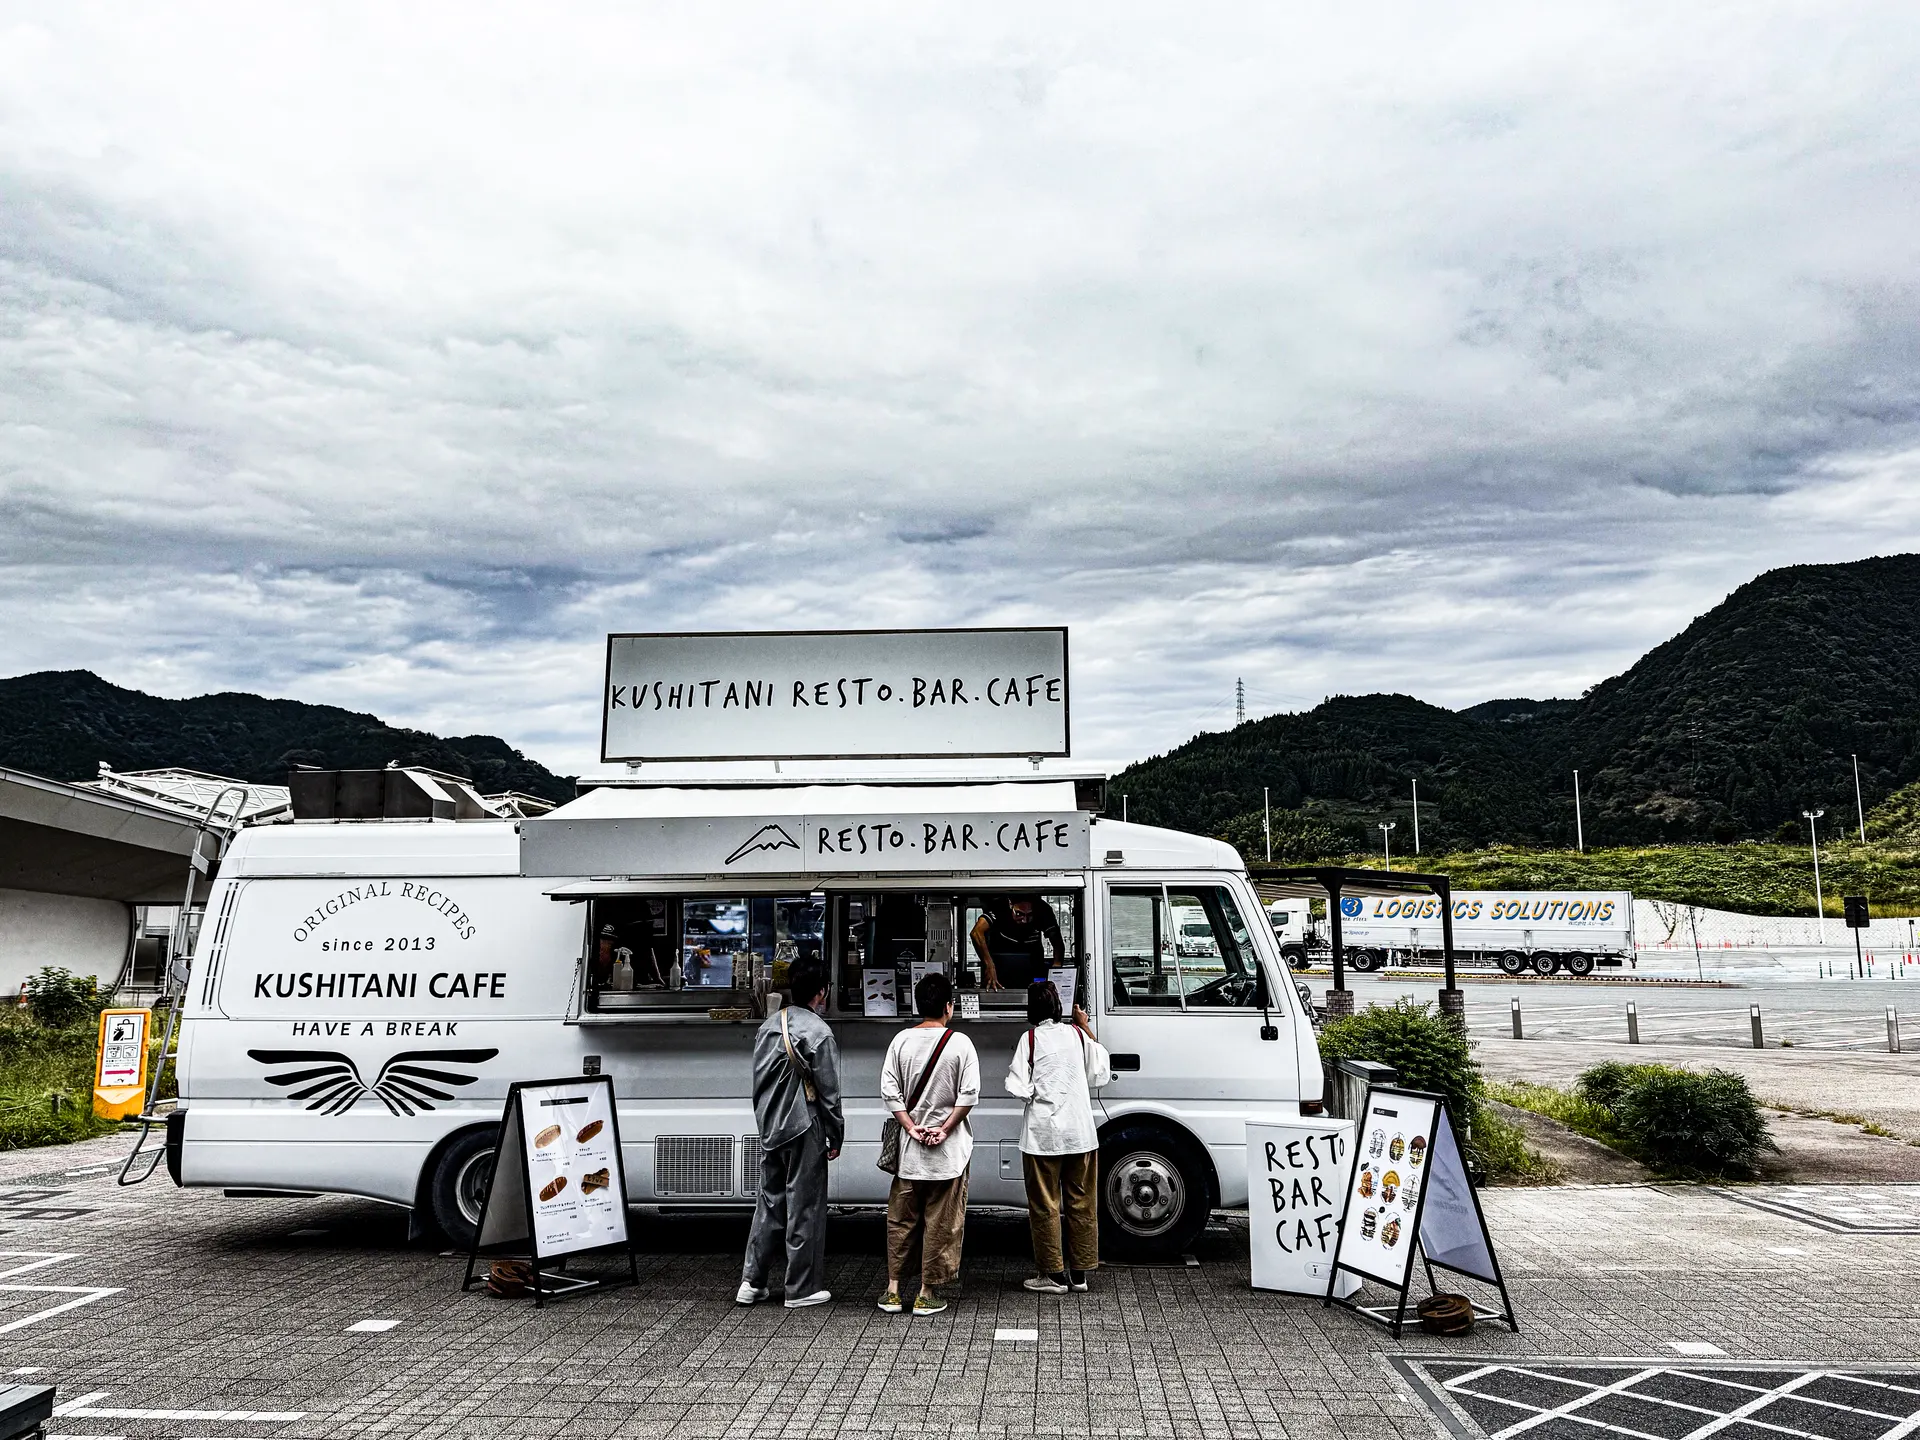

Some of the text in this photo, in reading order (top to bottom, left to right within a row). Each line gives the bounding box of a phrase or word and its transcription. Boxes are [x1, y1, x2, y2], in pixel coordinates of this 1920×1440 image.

[611, 680, 774, 710] KUSHITANI
[293, 881, 476, 942] ORIGINAL RECIPES
[1490, 899, 1615, 921] SOLUTIONS
[321, 936, 436, 951] since 2013
[254, 972, 507, 998] KUSHITANI CAFE
[292, 1022, 459, 1036] HAVE A BREAK
[1264, 1132, 1345, 1172] RESTO
[1268, 1176, 1332, 1213] BAR
